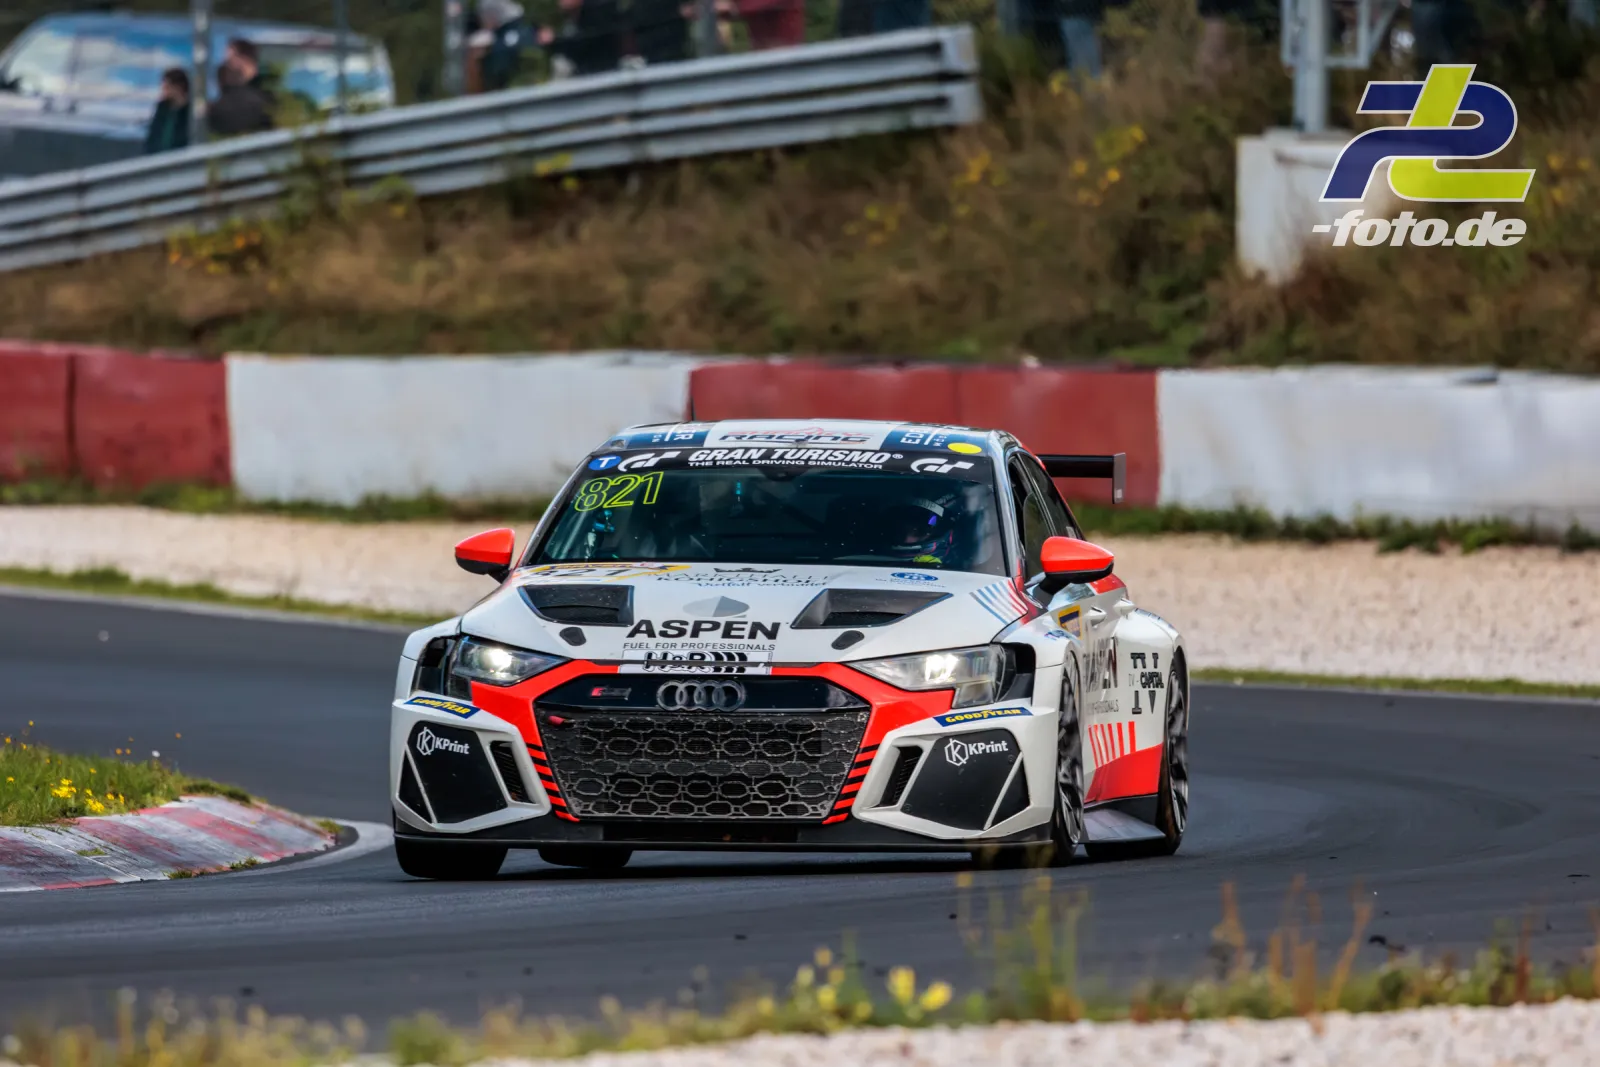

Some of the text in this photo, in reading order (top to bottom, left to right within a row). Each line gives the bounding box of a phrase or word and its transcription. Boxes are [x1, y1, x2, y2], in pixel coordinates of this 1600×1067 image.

[688, 448, 767, 461] GRAN
[808, 460, 882, 469] SIMULATOR
[574, 471, 664, 512] 821
[626, 619, 781, 640] ASPEN
[681, 642, 775, 651] PROFESSIONALS
[945, 708, 1023, 723] GOODYEAR
[435, 737, 470, 755] KPrint
[968, 740, 1009, 755] KPrint
